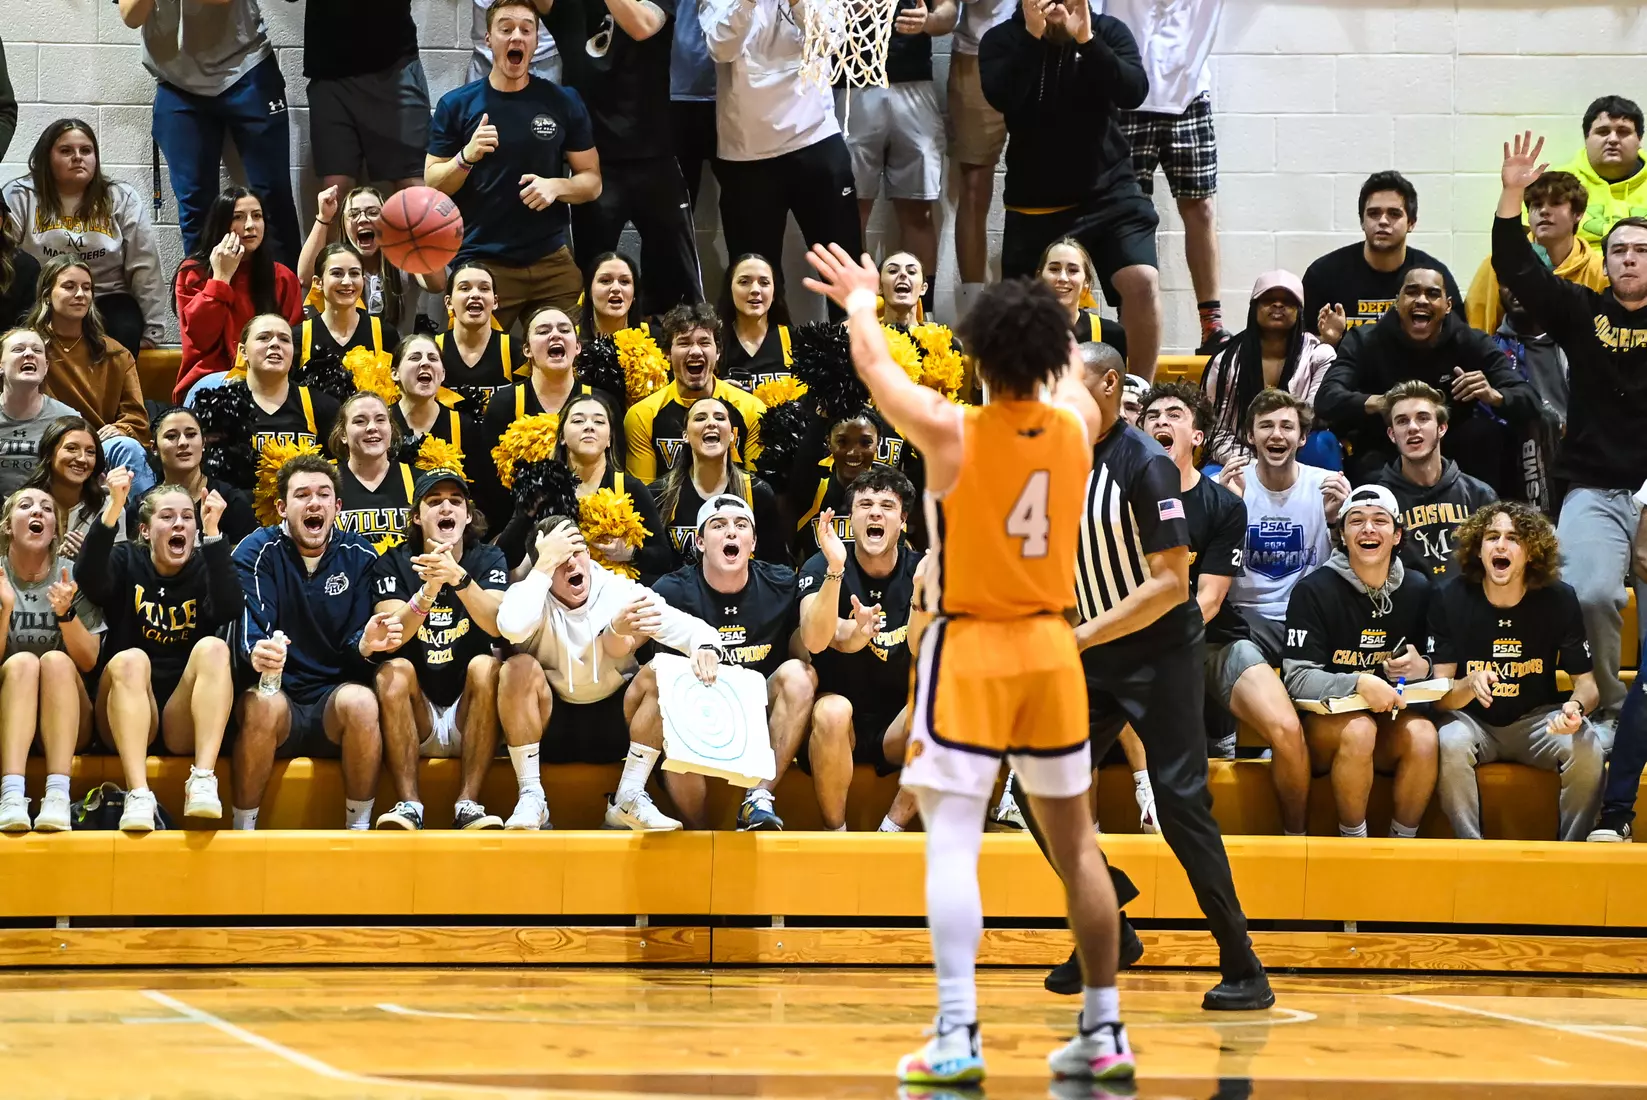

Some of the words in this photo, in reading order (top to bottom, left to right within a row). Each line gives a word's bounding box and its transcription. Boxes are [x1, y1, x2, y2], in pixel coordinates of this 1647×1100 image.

[43, 246, 106, 261] MADERS
[1005, 469, 1049, 556] 4
[1260, 522, 1292, 531] PSAC
[489, 569, 506, 584] 23
[376, 576, 397, 594] LW
[9, 610, 60, 631] VILL
[429, 612, 453, 621] PSAC
[720, 631, 747, 641] PSAC
[1287, 629, 1308, 648] RV
[1360, 635, 1387, 644] PSAC
[427, 647, 454, 664] 2021
[722, 644, 772, 665] MPIONS
[1493, 644, 1523, 653] PSAC
[1466, 658, 1544, 680] CHAMPIONS
[1491, 682, 1520, 697] 2021
